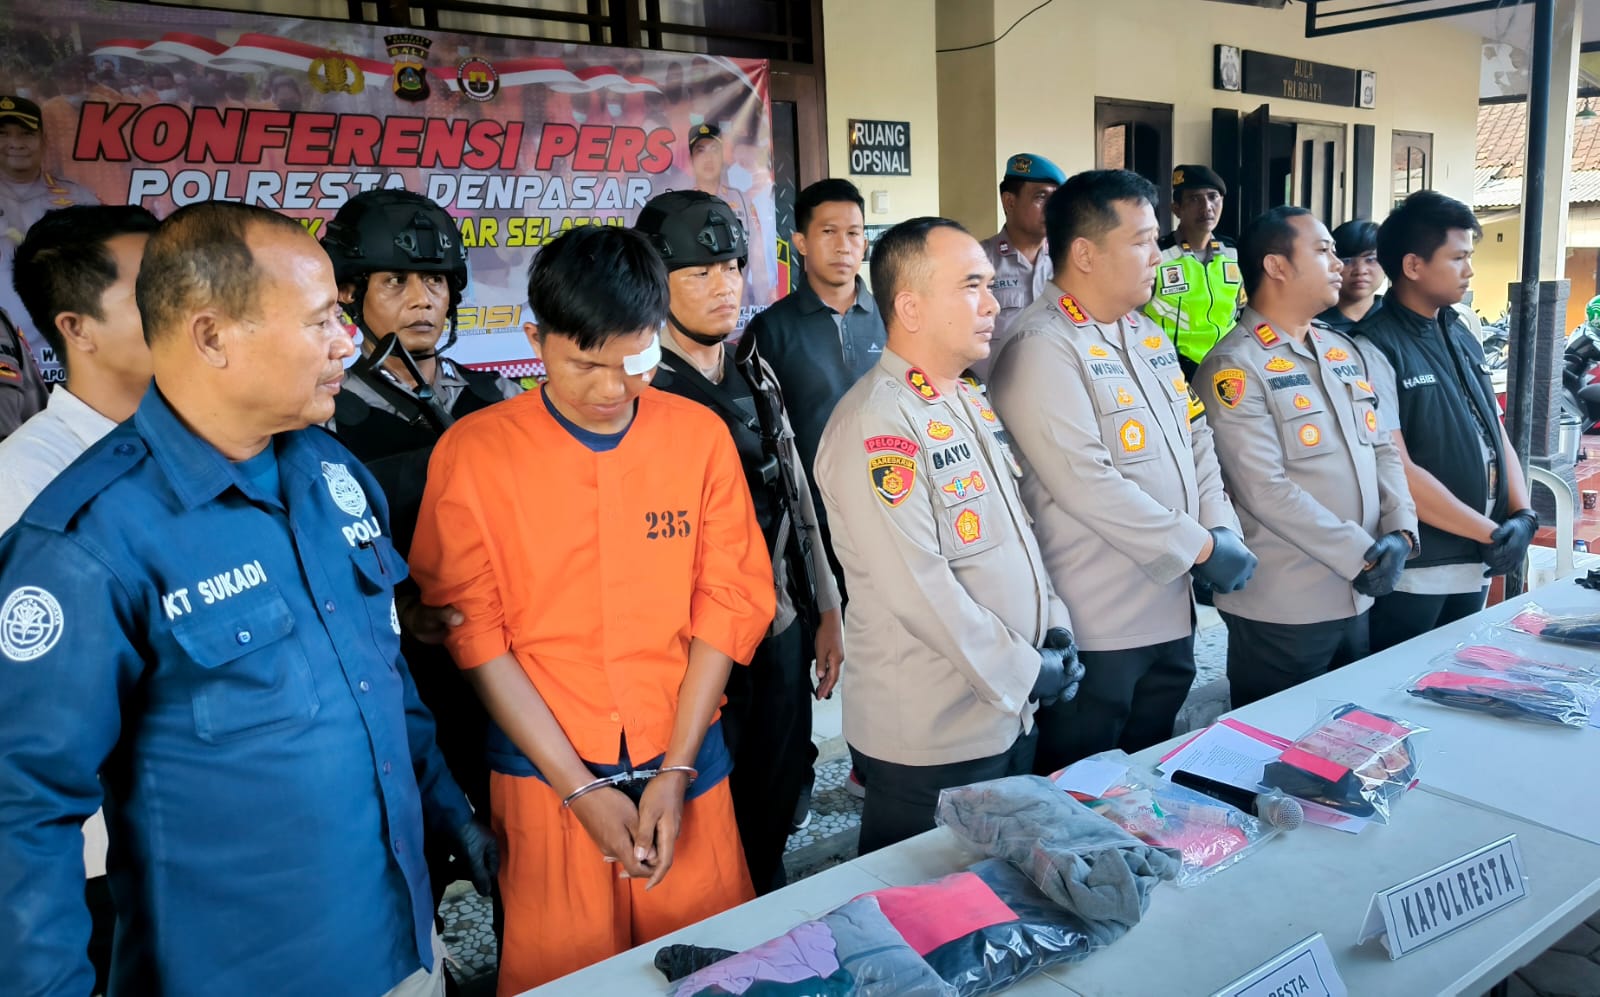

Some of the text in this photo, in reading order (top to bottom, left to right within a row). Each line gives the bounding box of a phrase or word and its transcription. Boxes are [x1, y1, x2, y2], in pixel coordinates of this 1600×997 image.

[1294, 61, 1313, 79] AULA
[1282, 79, 1322, 101] TRI BRATA
[73, 101, 676, 174] KONFERENSI PERS
[854, 123, 905, 147] RUANG
[852, 149, 909, 173] OPSNAL
[426, 174, 652, 210] DENPASAR
[1090, 363, 1125, 377] WISNU
[1402, 374, 1437, 389] HABIB
[868, 438, 915, 454] PELOPOR
[932, 443, 971, 469] BAYU
[645, 510, 691, 540] 235
[162, 559, 267, 621] KT SUKADI
[1400, 853, 1515, 938] KAPOLRESTA
